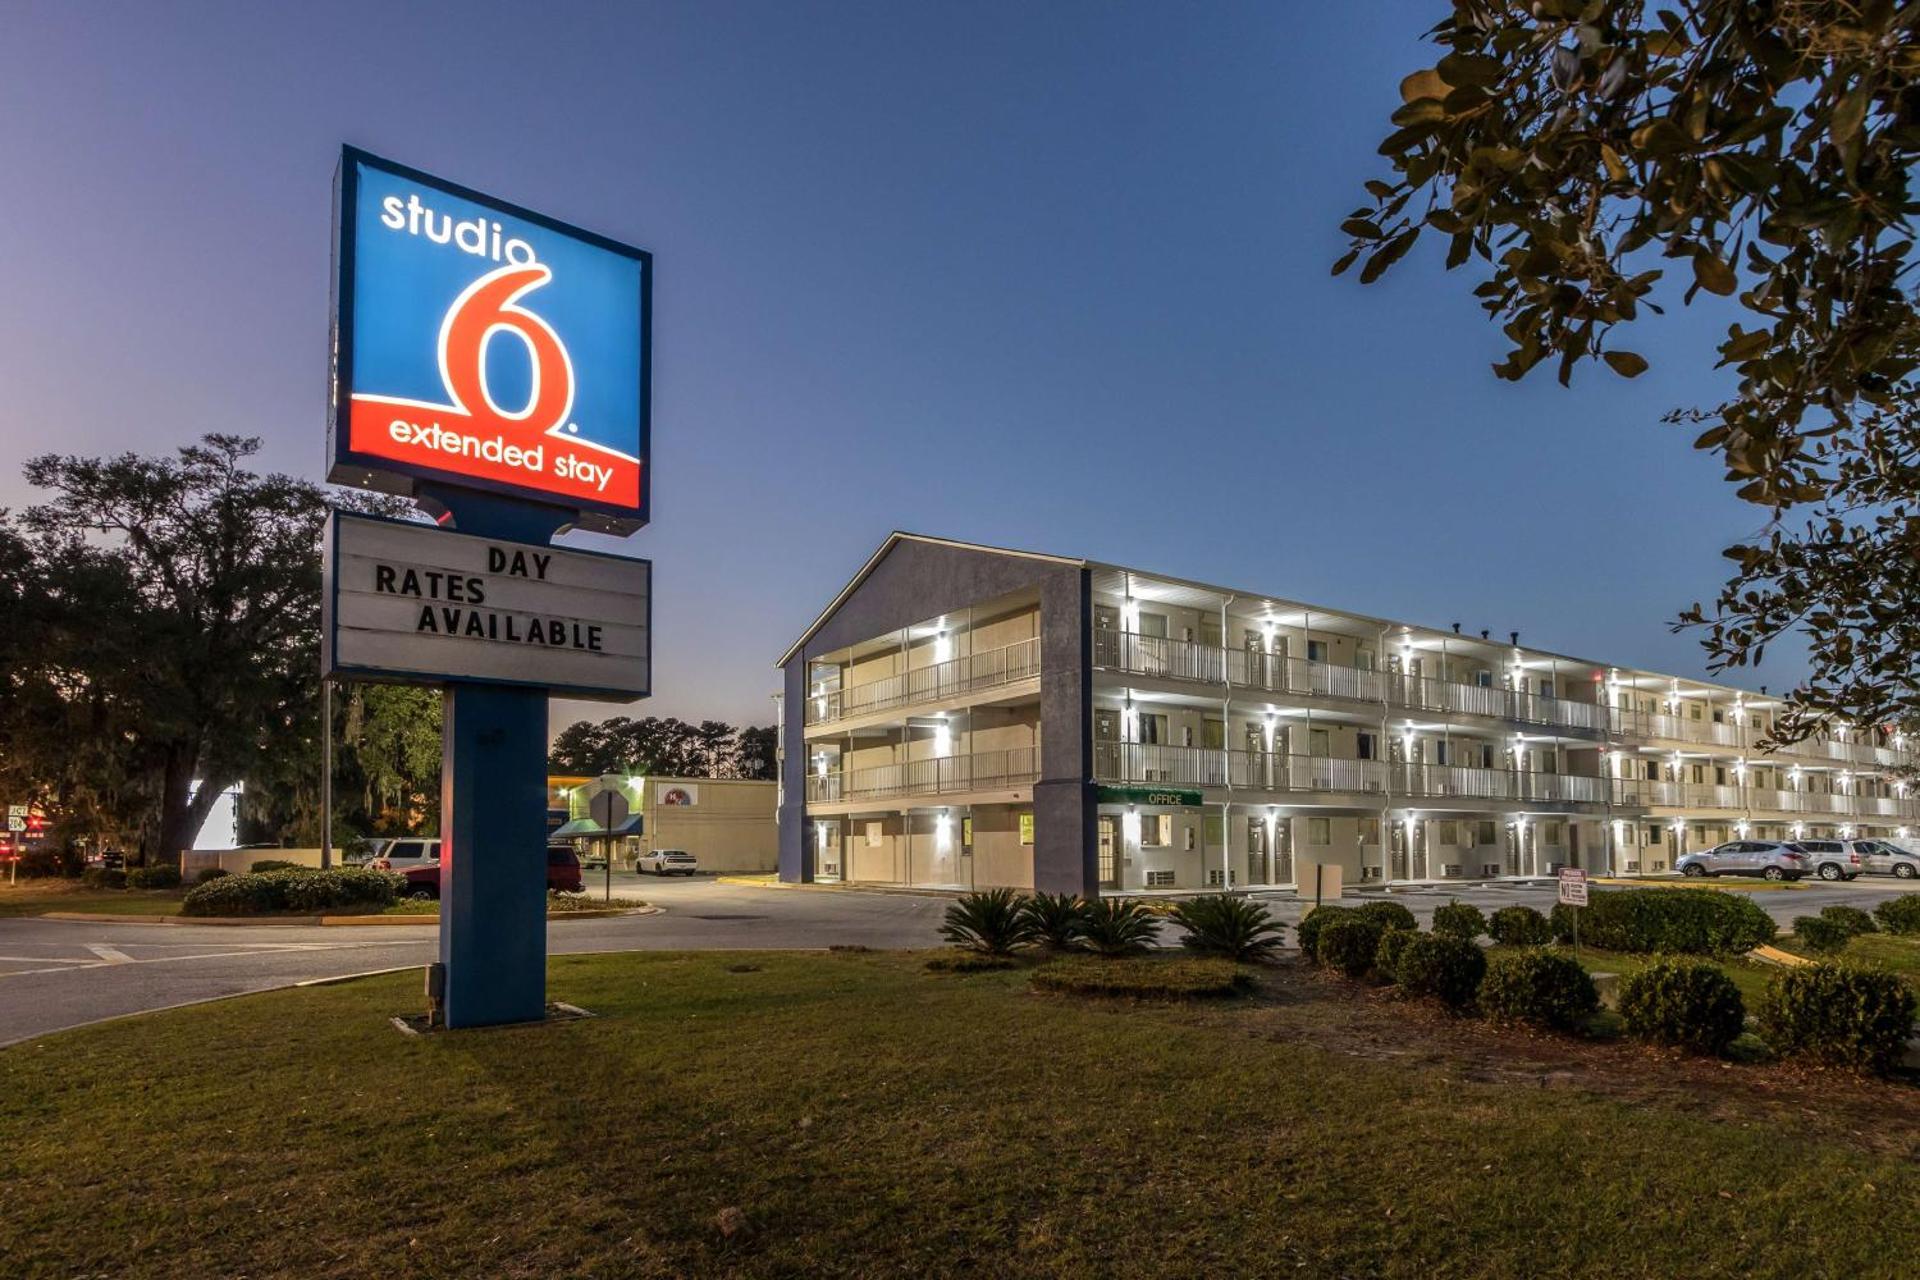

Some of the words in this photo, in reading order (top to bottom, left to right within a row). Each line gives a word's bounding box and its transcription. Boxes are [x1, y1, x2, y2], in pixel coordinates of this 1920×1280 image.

[381, 195, 536, 266] studio
[437, 262, 574, 434] 6
[389, 420, 543, 471] extended
[555, 454, 613, 491] stay
[376, 564, 485, 604] RATES
[489, 547, 551, 580] DAY
[417, 605, 602, 651] AVAILABLE
[1148, 793, 1182, 805] OFFICE
